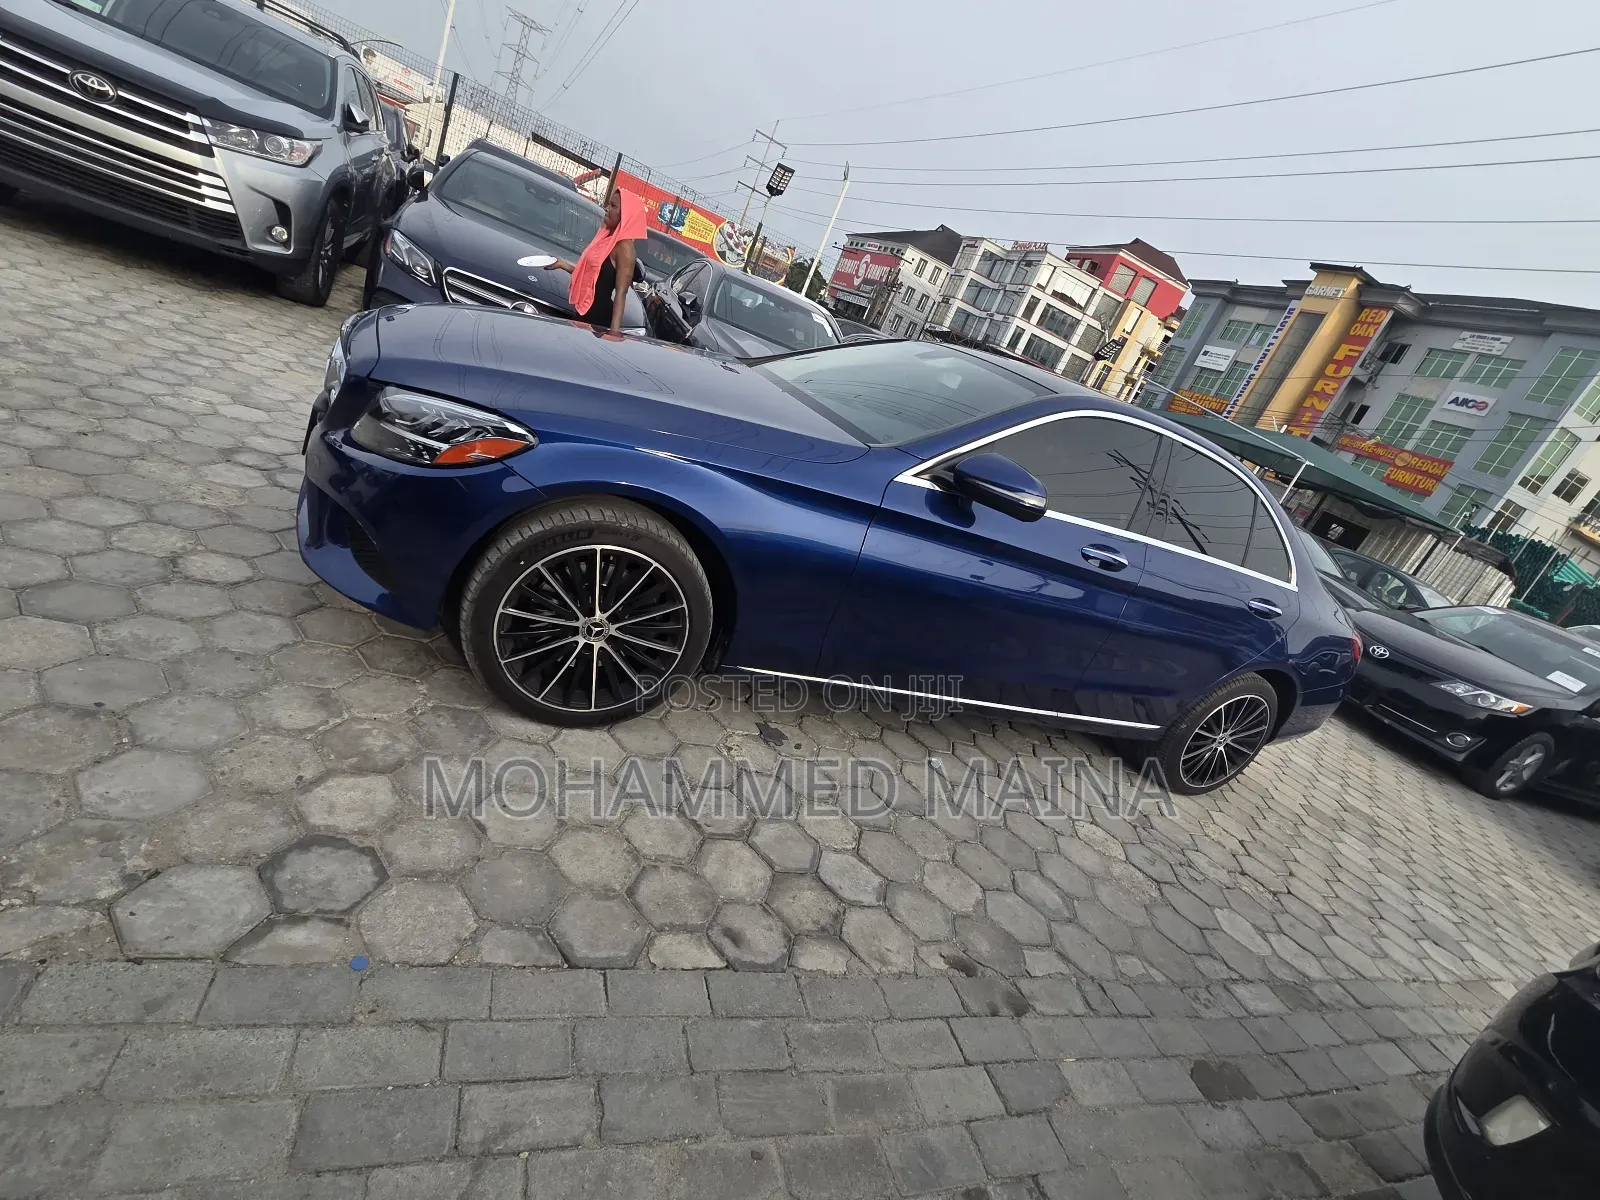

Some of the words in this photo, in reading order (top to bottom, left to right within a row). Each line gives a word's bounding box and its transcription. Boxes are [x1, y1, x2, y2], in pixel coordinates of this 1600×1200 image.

[1304, 284, 1347, 299] GARNET
[1357, 308, 1387, 323] RED
[1349, 323, 1379, 338] OAK
